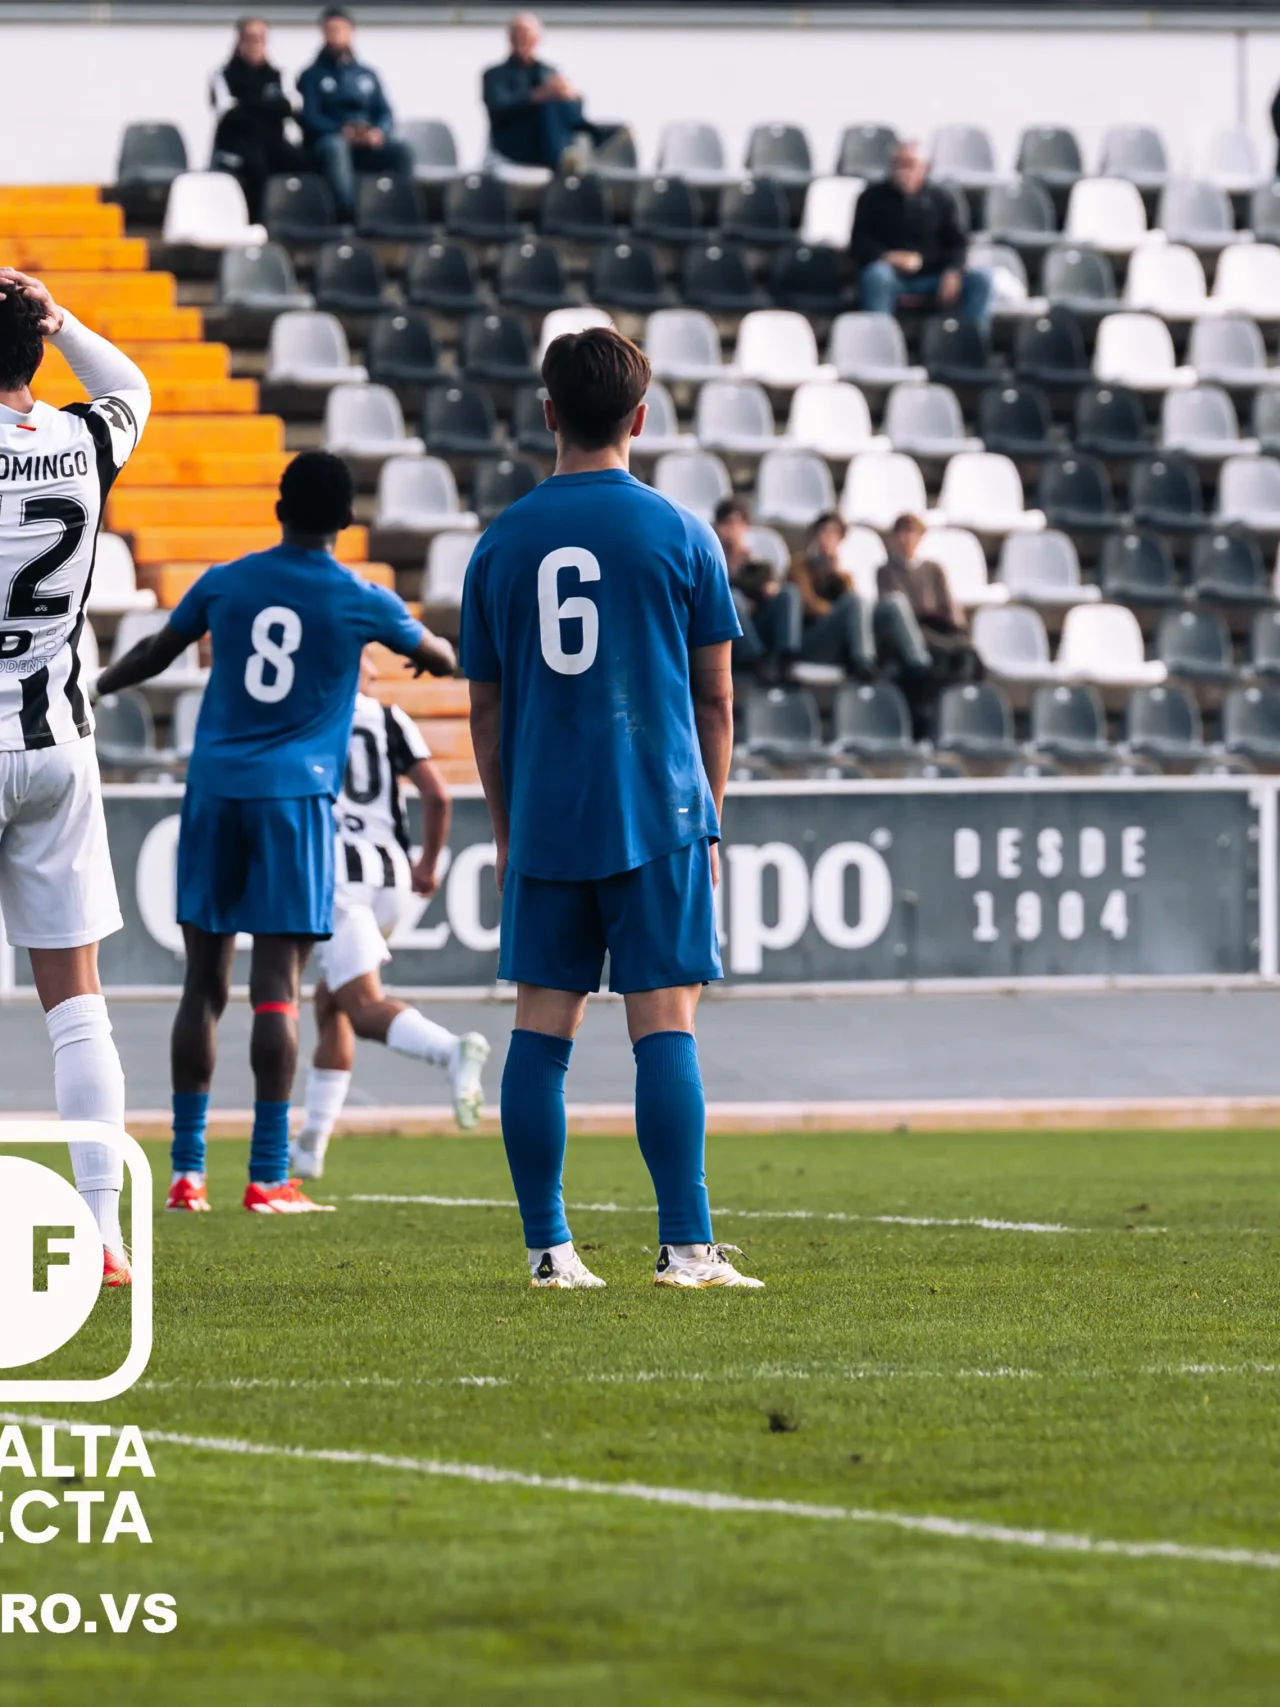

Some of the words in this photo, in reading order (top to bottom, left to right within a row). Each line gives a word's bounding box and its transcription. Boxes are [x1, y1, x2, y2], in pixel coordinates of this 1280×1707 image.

[537, 546, 601, 675] 6
[244, 605, 302, 703] 8
[953, 826, 1147, 879] DESDE
[972, 889, 1129, 942] 1904
